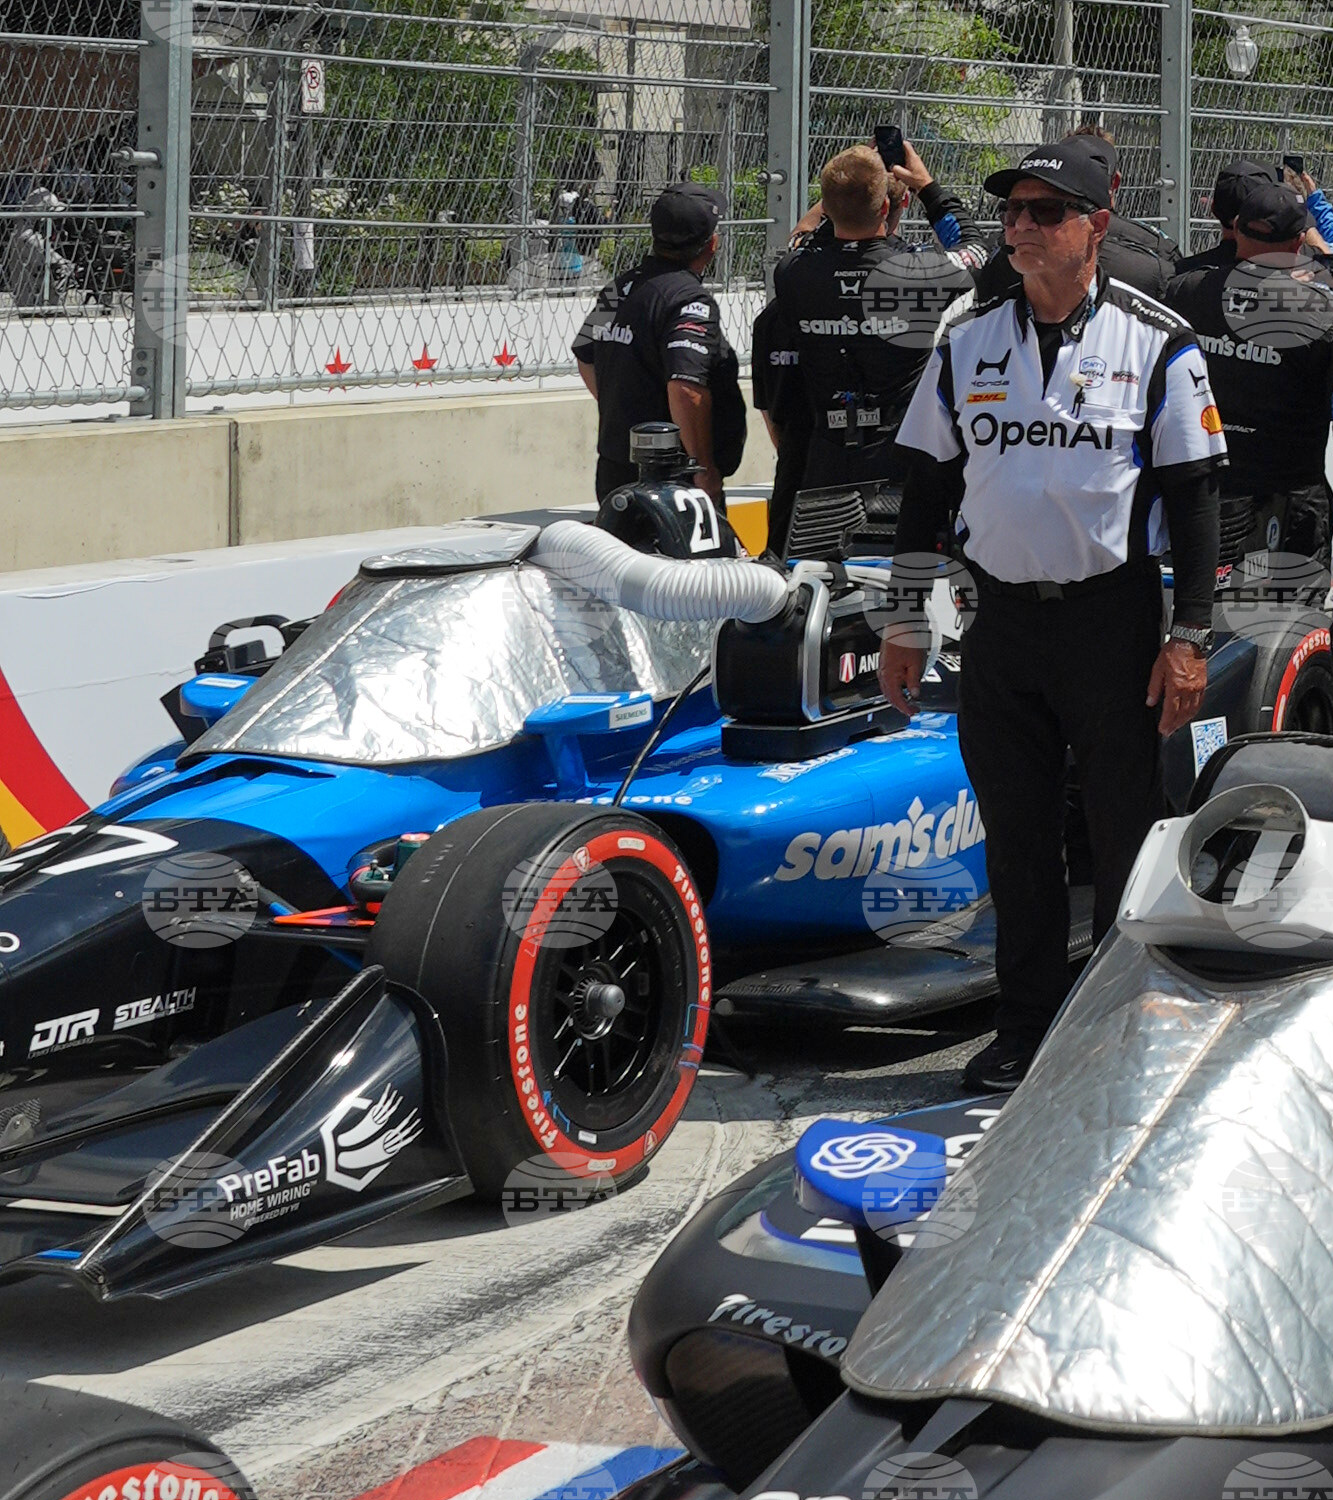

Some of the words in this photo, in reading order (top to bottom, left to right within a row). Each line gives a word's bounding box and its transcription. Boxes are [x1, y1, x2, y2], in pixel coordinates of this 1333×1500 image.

[1021, 159, 1063, 171] OpenAI
[799, 314, 859, 335] sam's
[860, 316, 910, 336] club
[1130, 299, 1179, 329] Firestone
[1236, 341, 1282, 366] club
[970, 412, 1113, 455] OpenAI
[674, 488, 721, 553] 27
[774, 794, 936, 882] sam's
[673, 865, 710, 1003] Firestone
[114, 986, 197, 1024] STEALTH
[29, 1008, 100, 1051] DTR
[514, 1002, 558, 1149] Firestone
[216, 1149, 321, 1204] PreFab
[229, 1199, 265, 1221] HOME
